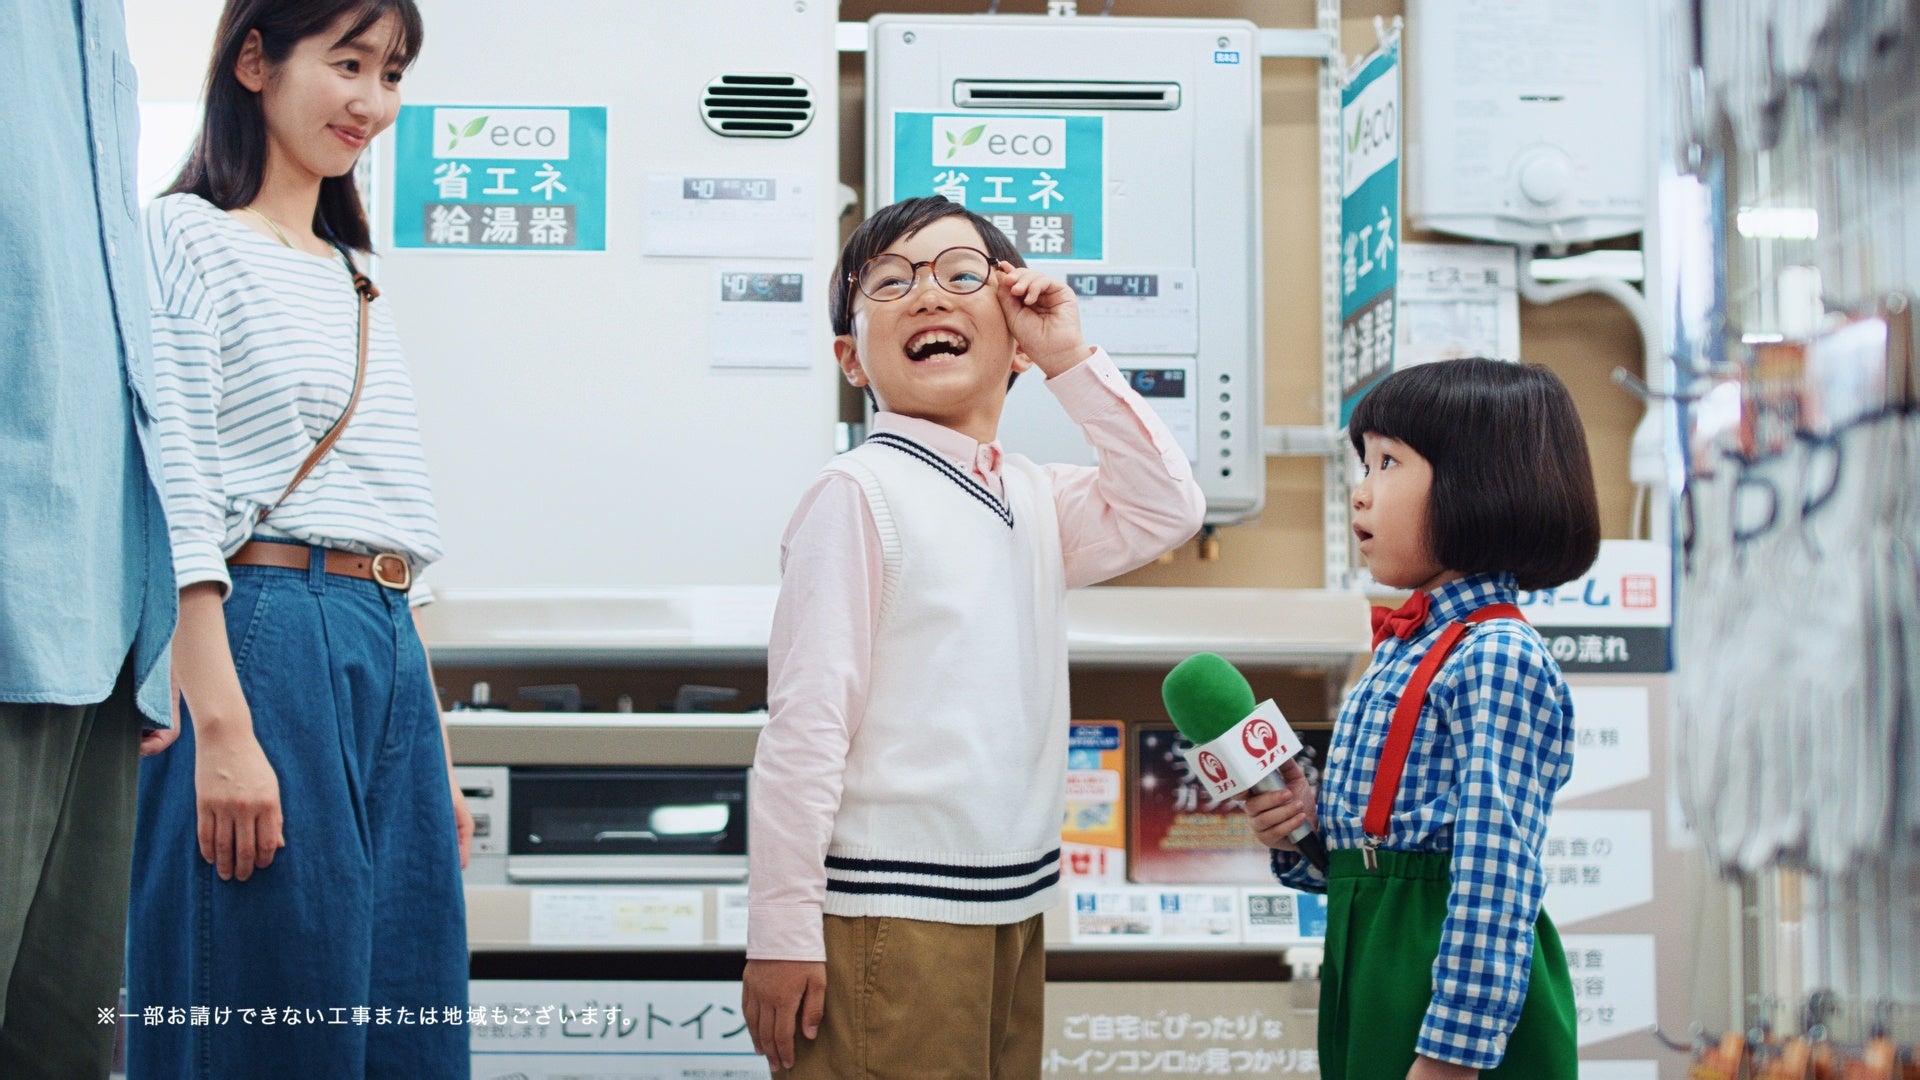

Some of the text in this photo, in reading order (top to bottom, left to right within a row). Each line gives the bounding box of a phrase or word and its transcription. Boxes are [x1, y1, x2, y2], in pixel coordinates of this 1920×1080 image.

[490, 124, 556, 147] eco
[1361, 101, 1395, 156] eco
[988, 133, 1053, 156] eco
[433, 161, 568, 201] 省エネ
[691, 180, 715, 198] 40
[745, 181, 767, 198] 40
[932, 170, 1065, 210] 省エネ
[430, 207, 569, 245] 給湯器
[1342, 204, 1395, 297] 省エネ
[723, 274, 748, 295] 40
[1073, 276, 1098, 295] 40
